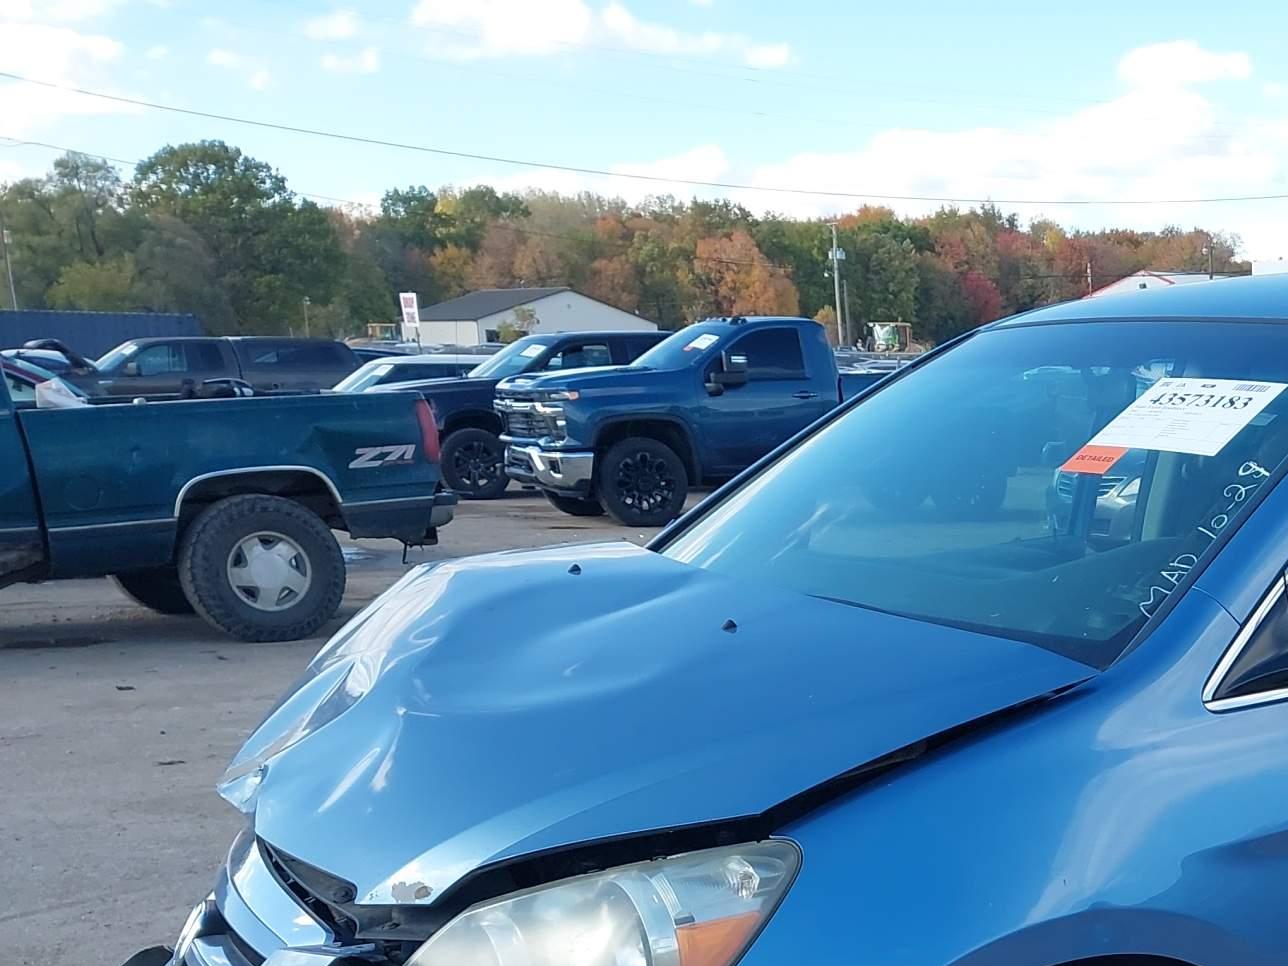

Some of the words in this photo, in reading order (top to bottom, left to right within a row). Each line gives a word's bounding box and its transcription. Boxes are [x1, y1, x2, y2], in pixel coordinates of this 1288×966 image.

[1150, 392, 1253, 410] 43573183
[348, 444, 416, 469] Z71
[1076, 454, 1115, 463] DETAILED
